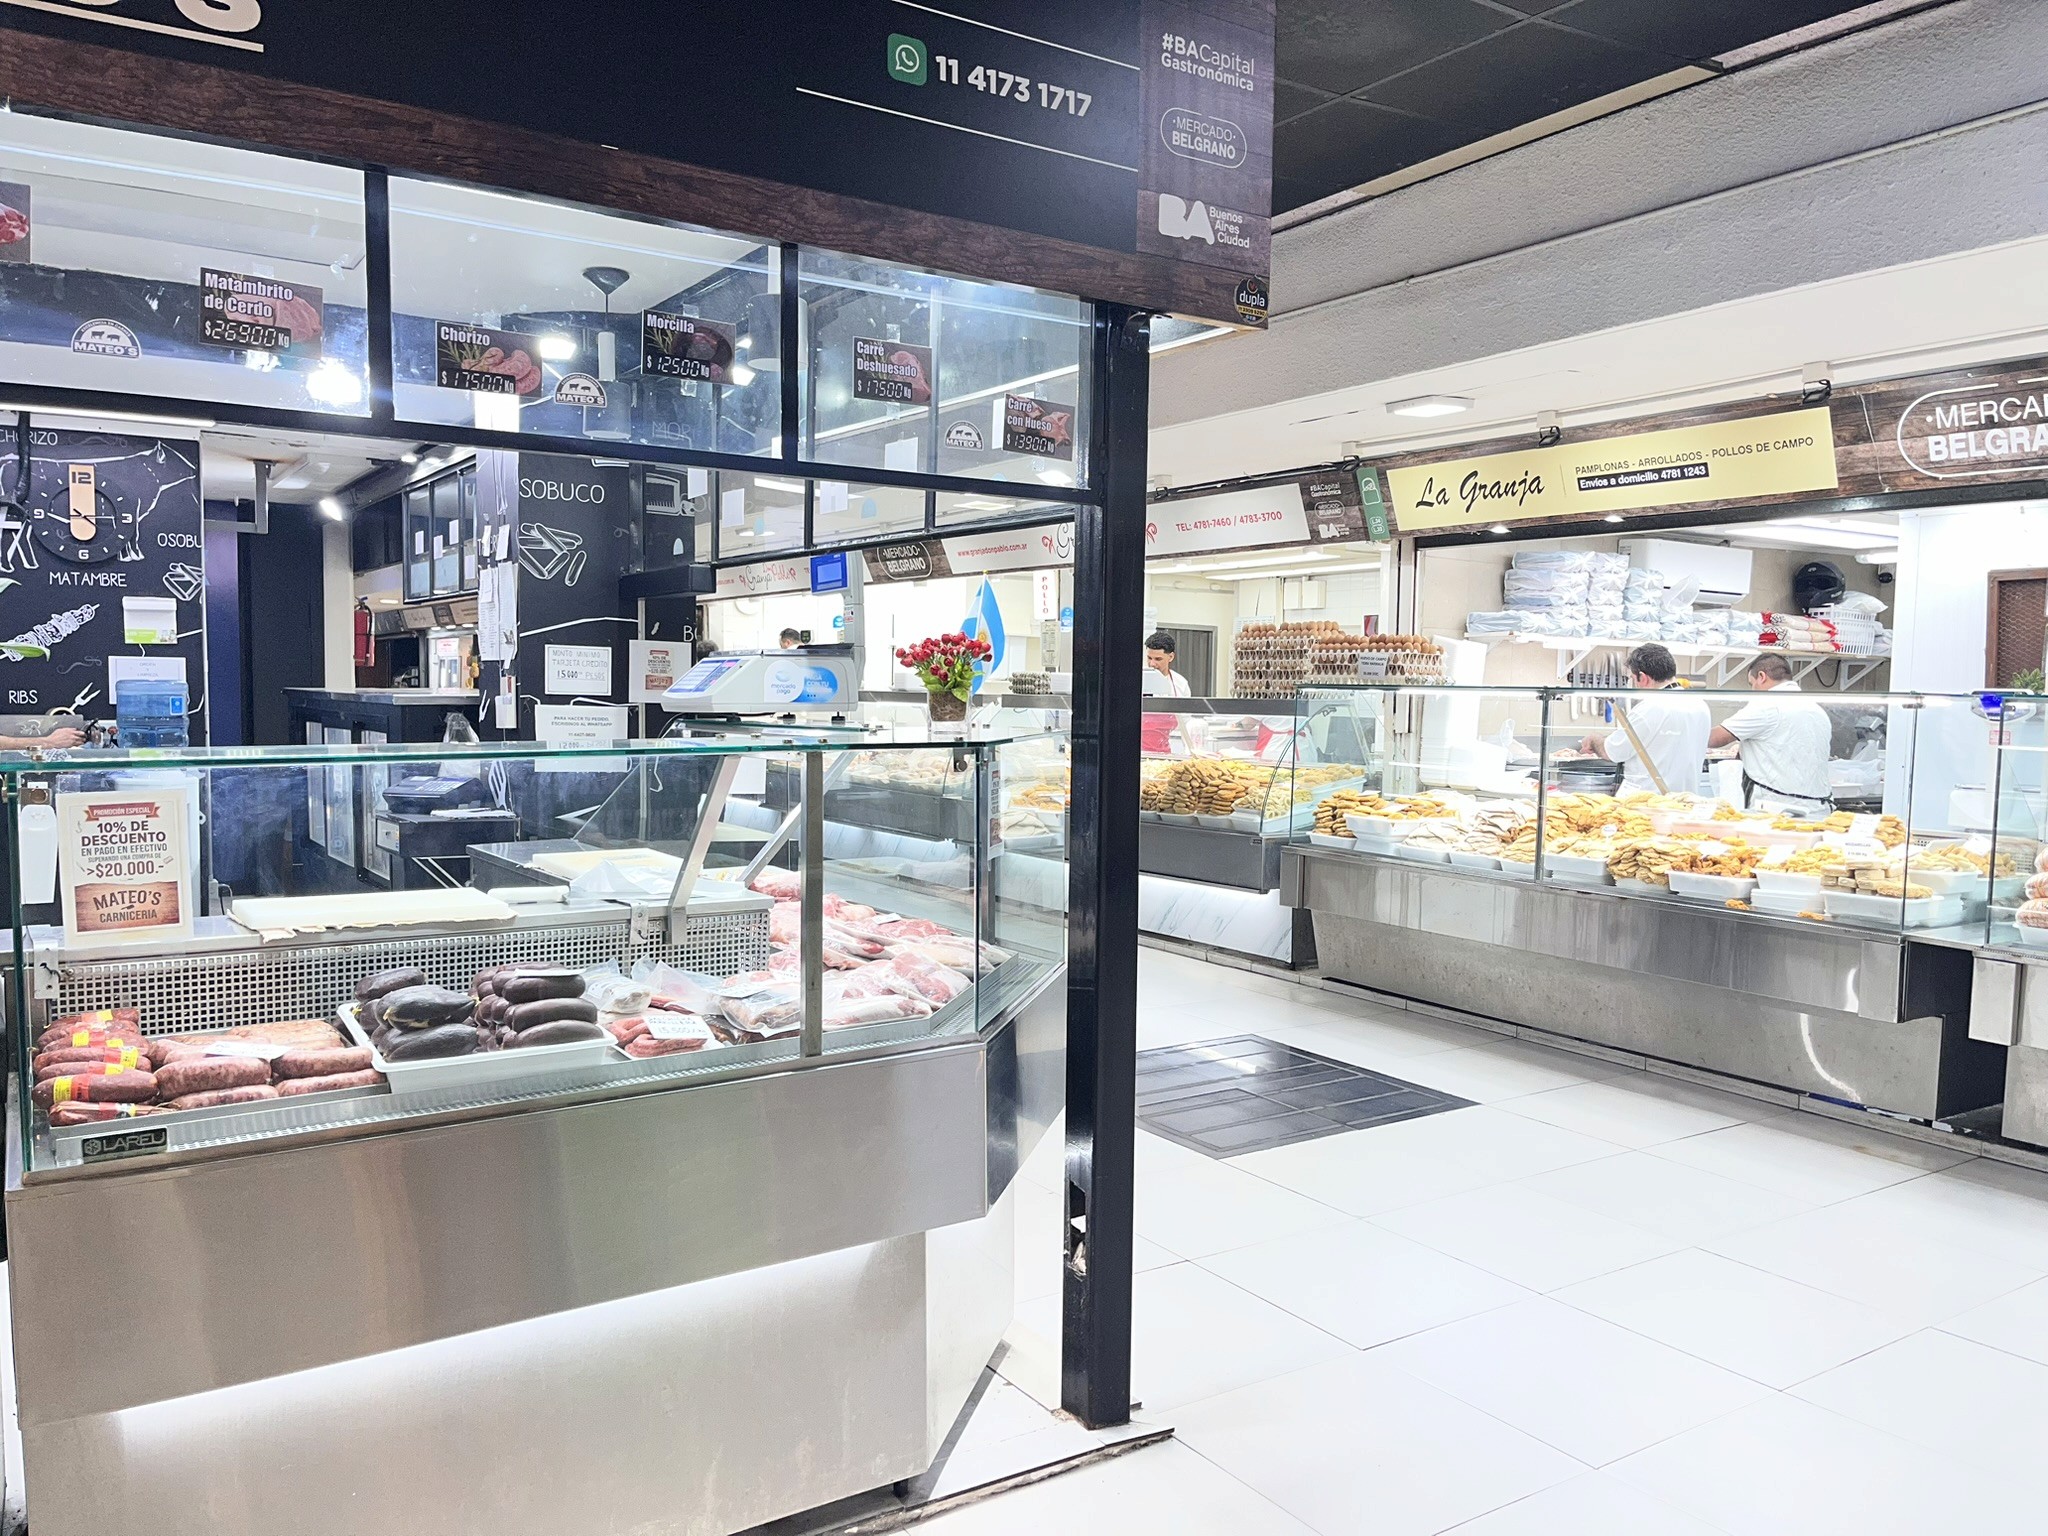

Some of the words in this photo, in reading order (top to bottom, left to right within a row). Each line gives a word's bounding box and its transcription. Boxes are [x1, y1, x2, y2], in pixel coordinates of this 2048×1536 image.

[1162, 33, 1254, 76] #BACapital
[1161, 52, 1254, 92] Gastronómica
[935, 56, 959, 85] 11
[967, 65, 1031, 103] 4173
[1037, 83, 1092, 117] 1717
[1172, 130, 1236, 160] BELGRANO
[1209, 206, 1243, 224] Buenos
[1214, 219, 1240, 235] Aires
[1217, 231, 1250, 249] Ciudad
[205, 272, 293, 300] Matambrito
[204, 294, 223, 309] de
[227, 297, 273, 317] Cerdo
[1239, 290, 1265, 307] dupla
[647, 313, 694, 333] Morcilla
[278, 332, 290, 348] Kg
[440, 326, 491, 346] Chorizo
[74, 342, 138, 356] MATEO'S
[857, 341, 884, 356] Carré
[657, 356, 700, 377] 12500
[701, 364, 710, 378] Kg
[857, 358, 917, 377] Deshuesado
[454, 371, 503, 393] 17500
[504, 380, 514, 394] Kg
[866, 380, 903, 399] 17500
[904, 386, 912, 399] Kg
[556, 393, 604, 405] MATEO'S
[1008, 397, 1032, 412] Carré
[1007, 414, 1023, 426] con
[1025, 416, 1052, 431] Hueso
[946, 438, 982, 448] MATEO'S
[1014, 434, 1047, 452] 13900
[1047, 440, 1055, 454] Kg
[1575, 460, 1630, 475] PAMPLONAS
[1638, 451, 1703, 467] ARROLLADOS
[1712, 444, 1753, 458] POLLOS
[1756, 442, 1770, 452] DE
[1773, 436, 1814, 450] CAMPO
[71, 471, 92, 485] 12
[1580, 477, 1608, 489] Envíos
[1610, 477, 1617, 485] a
[1618, 471, 1659, 485] domicilio
[1660, 468, 1681, 480] 4781
[1684, 465, 1706, 477] 1243
[1415, 477, 1450, 508] La
[1460, 470, 1545, 513] Granja
[122, 513, 133, 524] 3
[1176, 523, 1192, 532] TEL:
[1194, 517, 1231, 529] 4781-7460
[1240, 511, 1282, 524] 4783-3700
[886, 557, 926, 573] BELGRANO
[49, 571, 128, 587] MATAMBRE
[8, 689, 39, 705] RIBS
[94, 807, 125, 816] PROMOCIÓN
[126, 806, 151, 814] ESPECIAL
[97, 821, 127, 834] 10%
[131, 820, 149, 831] DE
[81, 831, 166, 847] DESCUENTO
[81, 847, 92, 856] EN
[94, 846, 115, 855] PAGO
[117, 845, 128, 854] EN
[130, 843, 168, 853] EFECTIVO
[88, 855, 119, 863] SUPERANDO
[132, 852, 154, 860] COMPRA
[93, 889, 162, 911] MATEO'S
[100, 908, 158, 923] CARNICERIA
